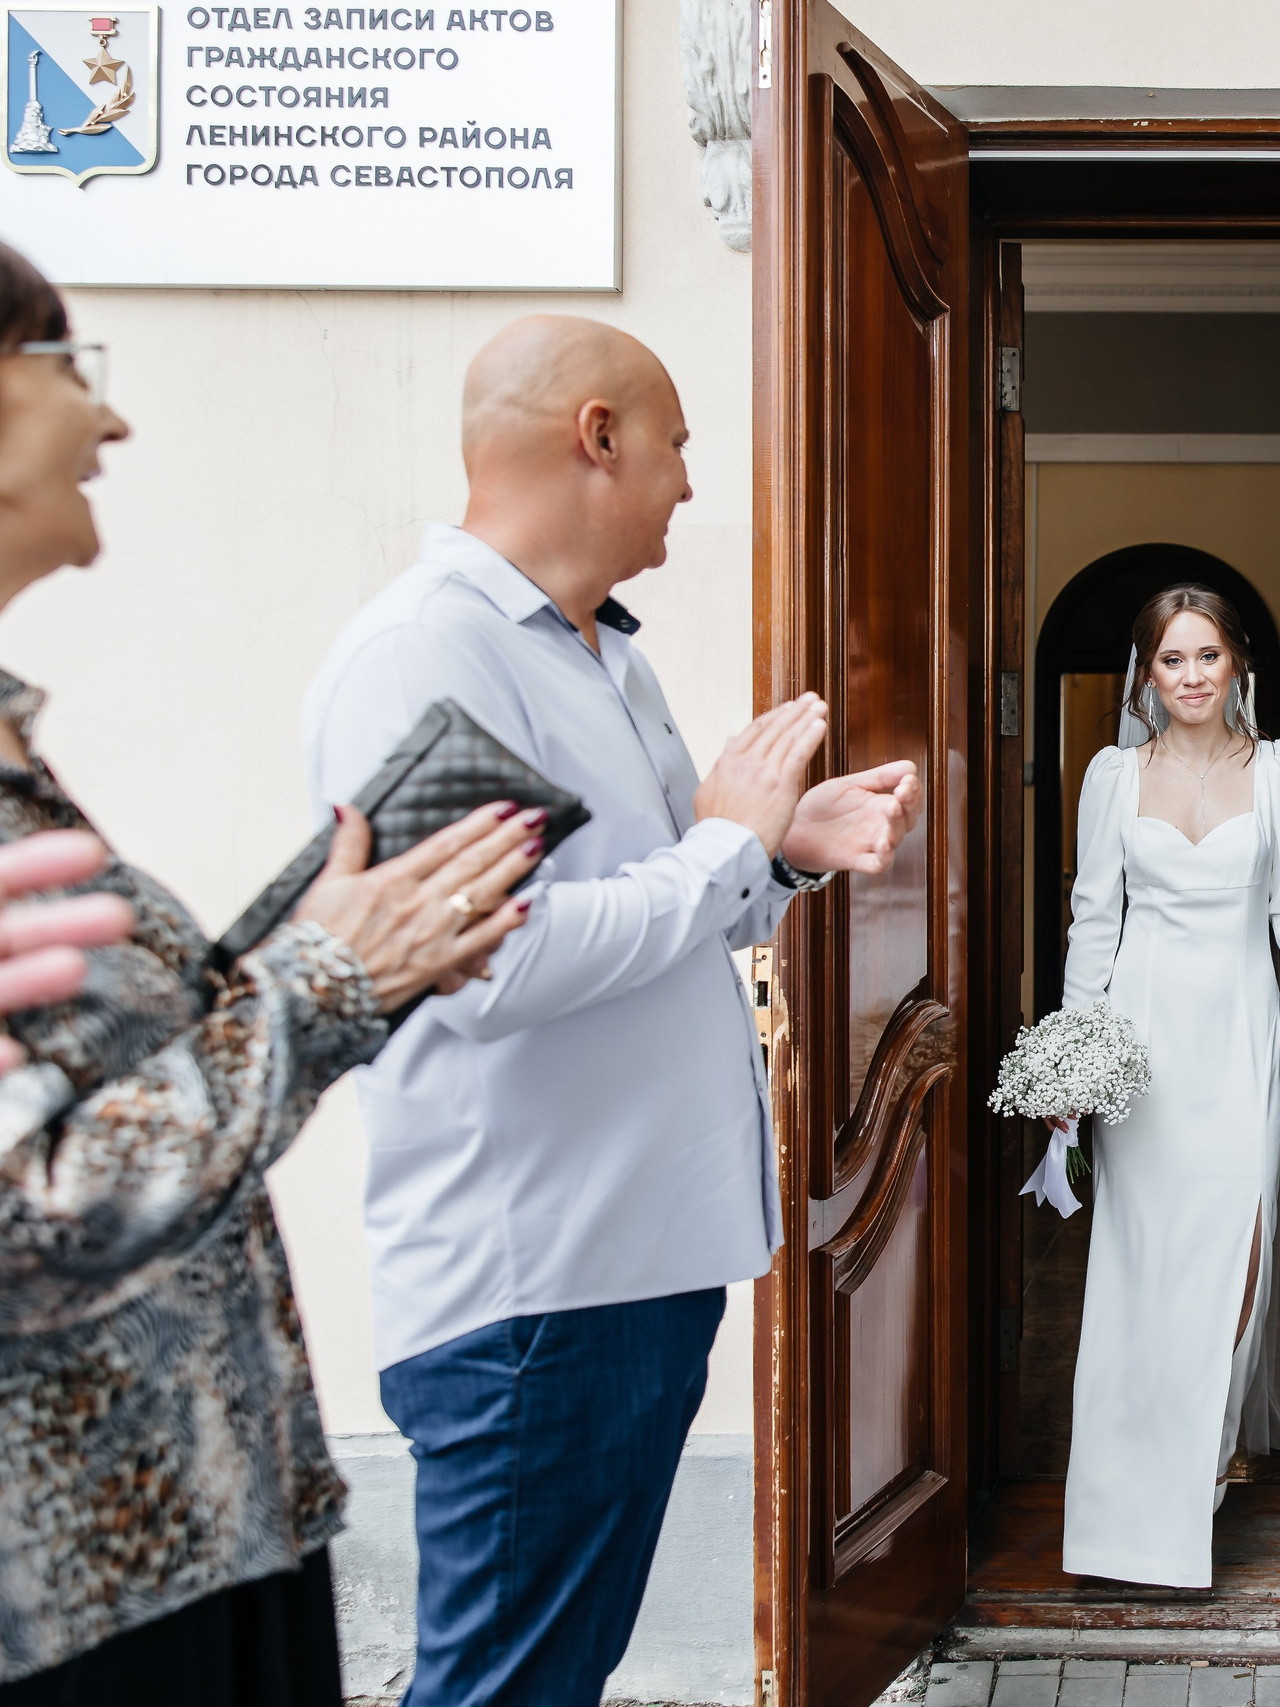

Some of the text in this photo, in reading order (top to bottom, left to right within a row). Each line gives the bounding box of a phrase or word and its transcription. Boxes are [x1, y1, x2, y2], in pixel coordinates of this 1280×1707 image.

[187, 7, 554, 32] ОТДЕЛ ЗАПИСИ АКТОВ
[187, 46, 458, 71] ГРАЖДАНСКОГО
[186, 85, 389, 108] СОСТОЯНИЯ
[186, 121, 552, 150] ЛЕНИНСКОГО РАЙОНА
[187, 164, 573, 189] ГОРОДА СЕВАСТОПОЛЯ
